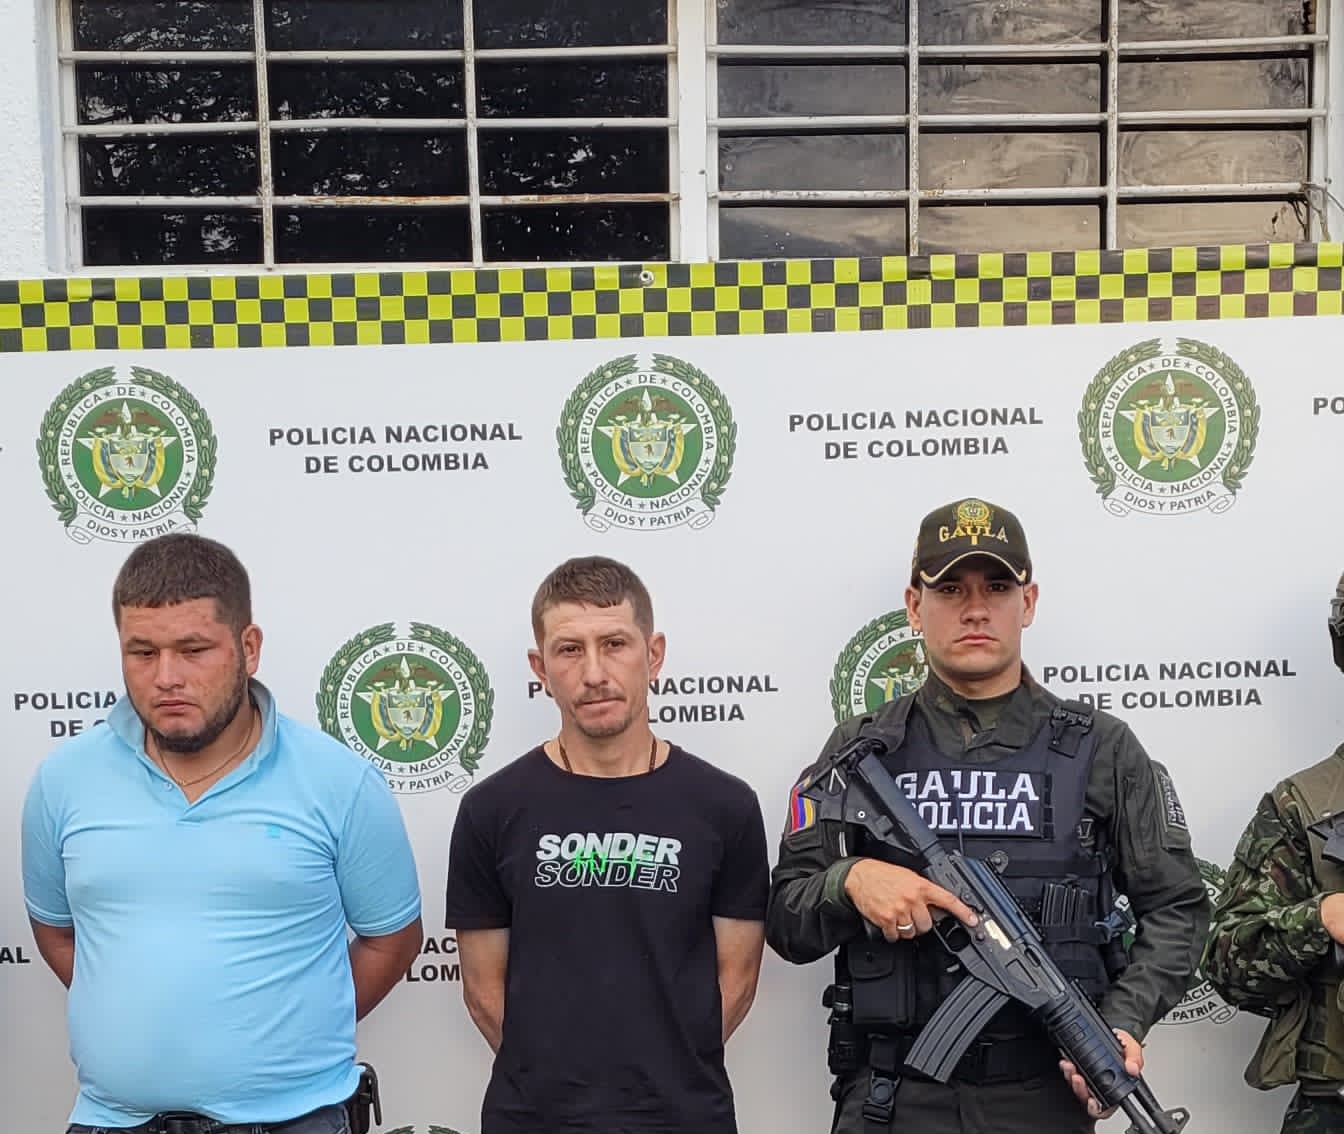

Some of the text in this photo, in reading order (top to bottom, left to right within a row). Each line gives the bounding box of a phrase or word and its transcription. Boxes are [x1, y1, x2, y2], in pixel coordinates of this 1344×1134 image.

[638, 374, 656, 383] DE
[671, 381, 714, 450] COLOMBIA
[790, 408, 1042, 432] POLICIA NACIONAL
[270, 423, 522, 445] POLICIA NACIONAL
[825, 437, 1008, 459] DE COLOMBIA
[305, 453, 488, 473] DE COLOMBIA
[649, 465, 709, 508] NACIONAL
[649, 506, 695, 525] PATRIA
[939, 525, 1009, 544] GAULA
[1044, 660, 1296, 683] POLICIA NACIONAL
[1122, 689, 1261, 709] COLOMBIA
[50, 720, 83, 738] DE
[914, 802, 1034, 830] OLICIA
[536, 832, 682, 865] SONDER
[534, 860, 681, 893] SONDER
